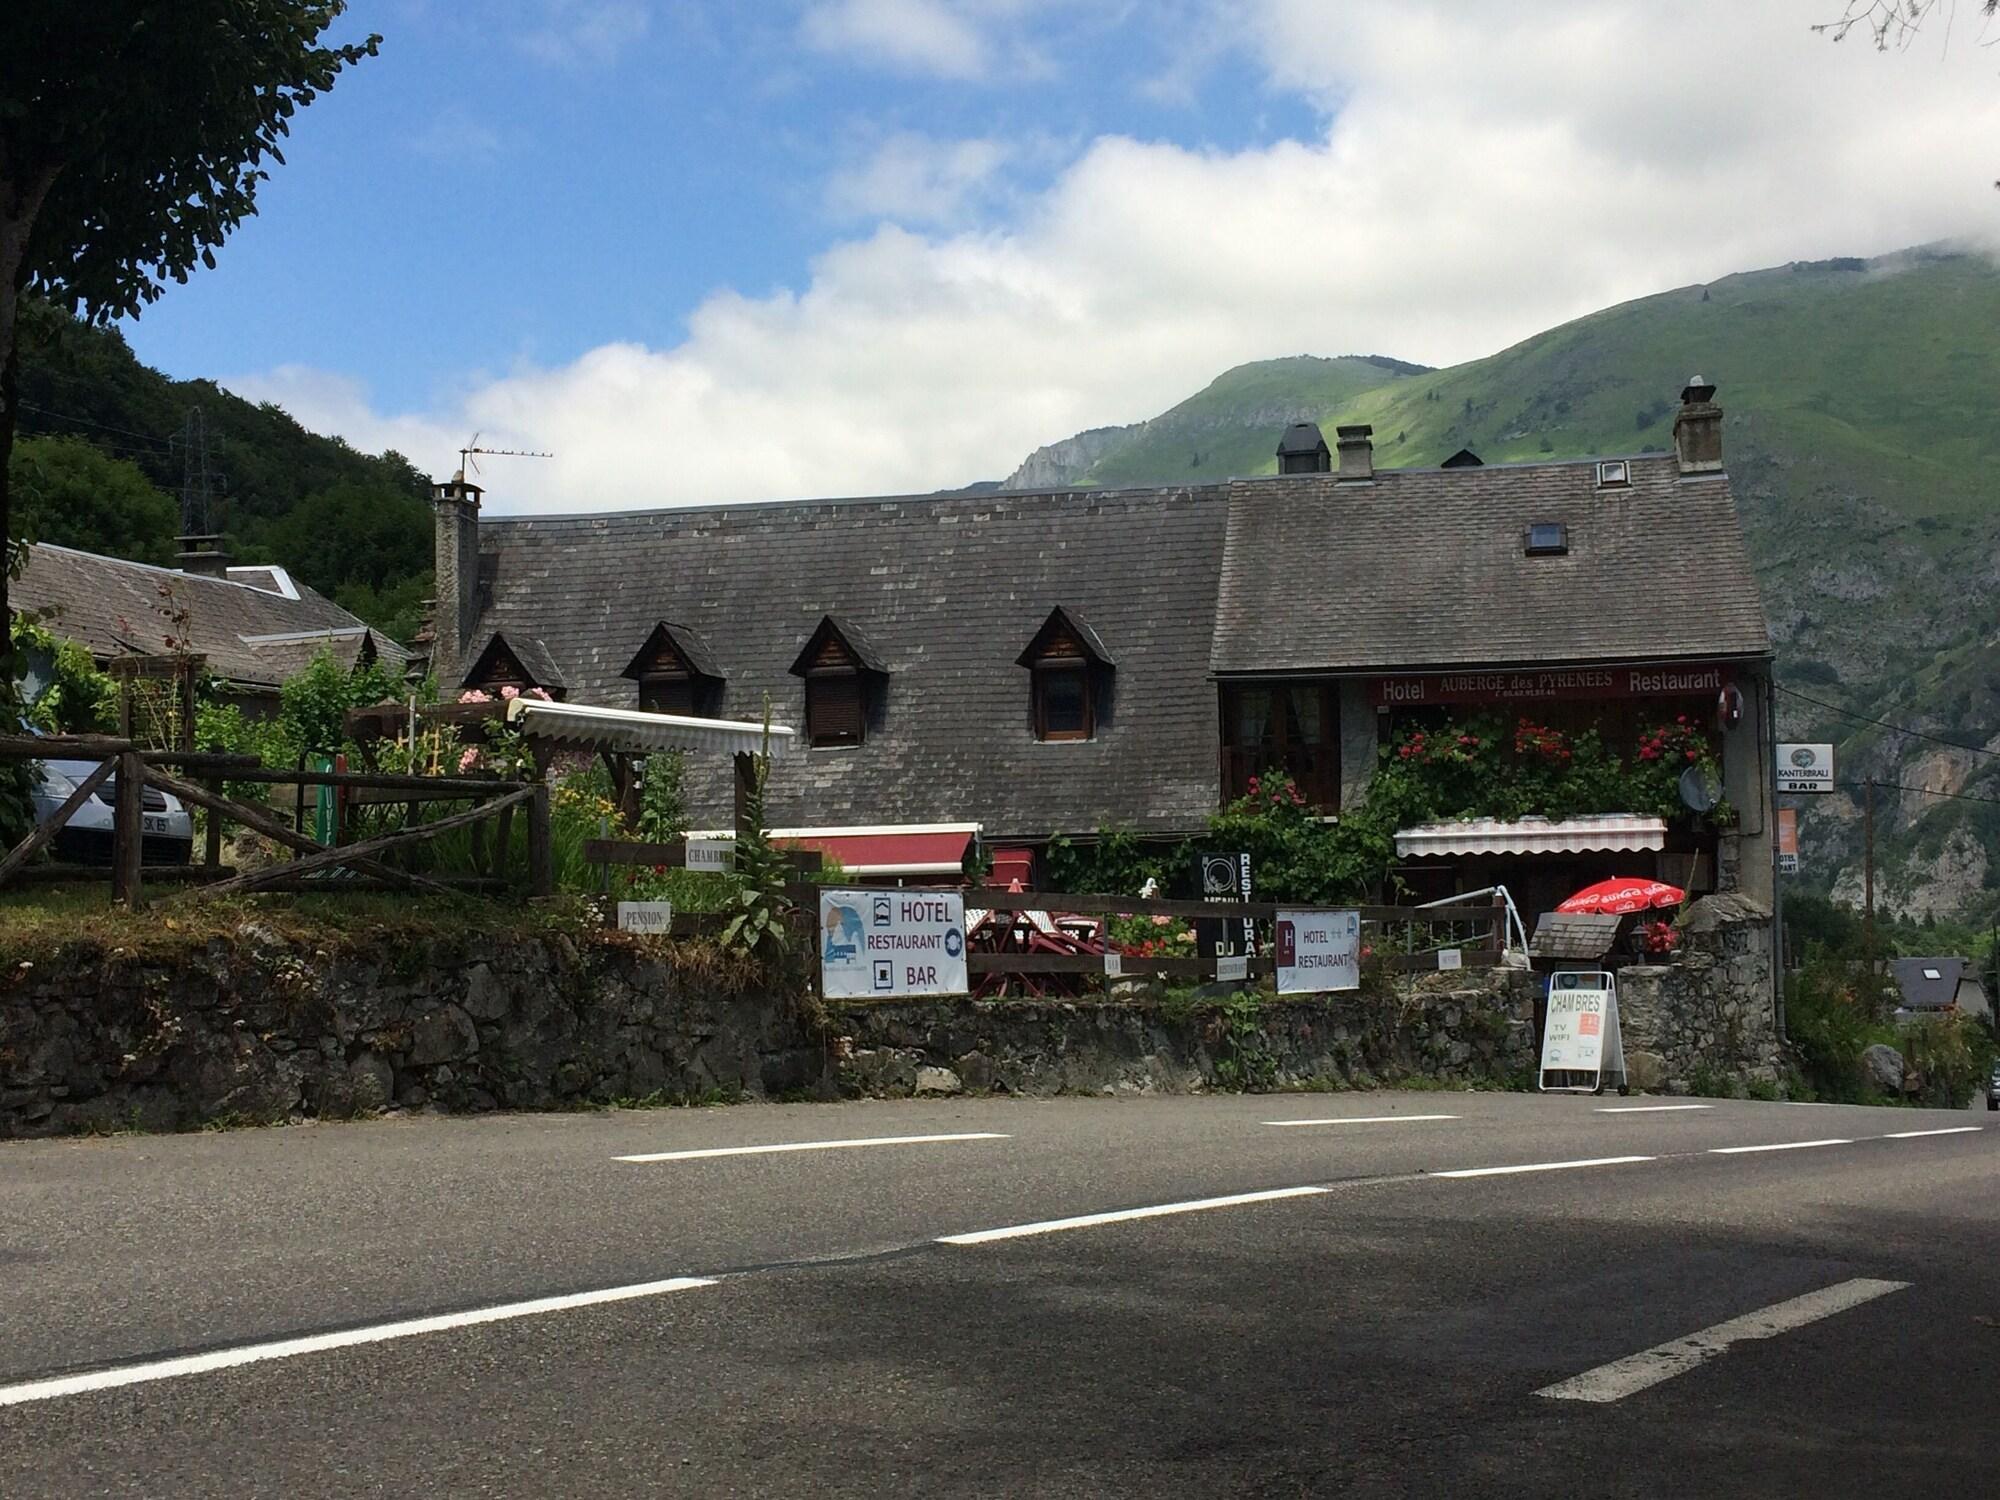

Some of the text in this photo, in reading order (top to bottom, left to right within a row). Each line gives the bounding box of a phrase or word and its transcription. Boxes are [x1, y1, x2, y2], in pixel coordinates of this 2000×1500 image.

[1440, 676, 1505, 692] AUBERGE
[1511, 675, 1533, 689] des
[1629, 669, 1721, 692] Restaurant
[1384, 680, 1425, 700] Hotel
[626, 911, 663, 926] PENSION
[901, 901, 953, 923] HOTEL
[868, 935, 942, 950] RESTAURANT
[1303, 930, 1329, 944] HOTEL
[1298, 953, 1349, 969] RESTAURANT
[906, 966, 938, 986] BAR
